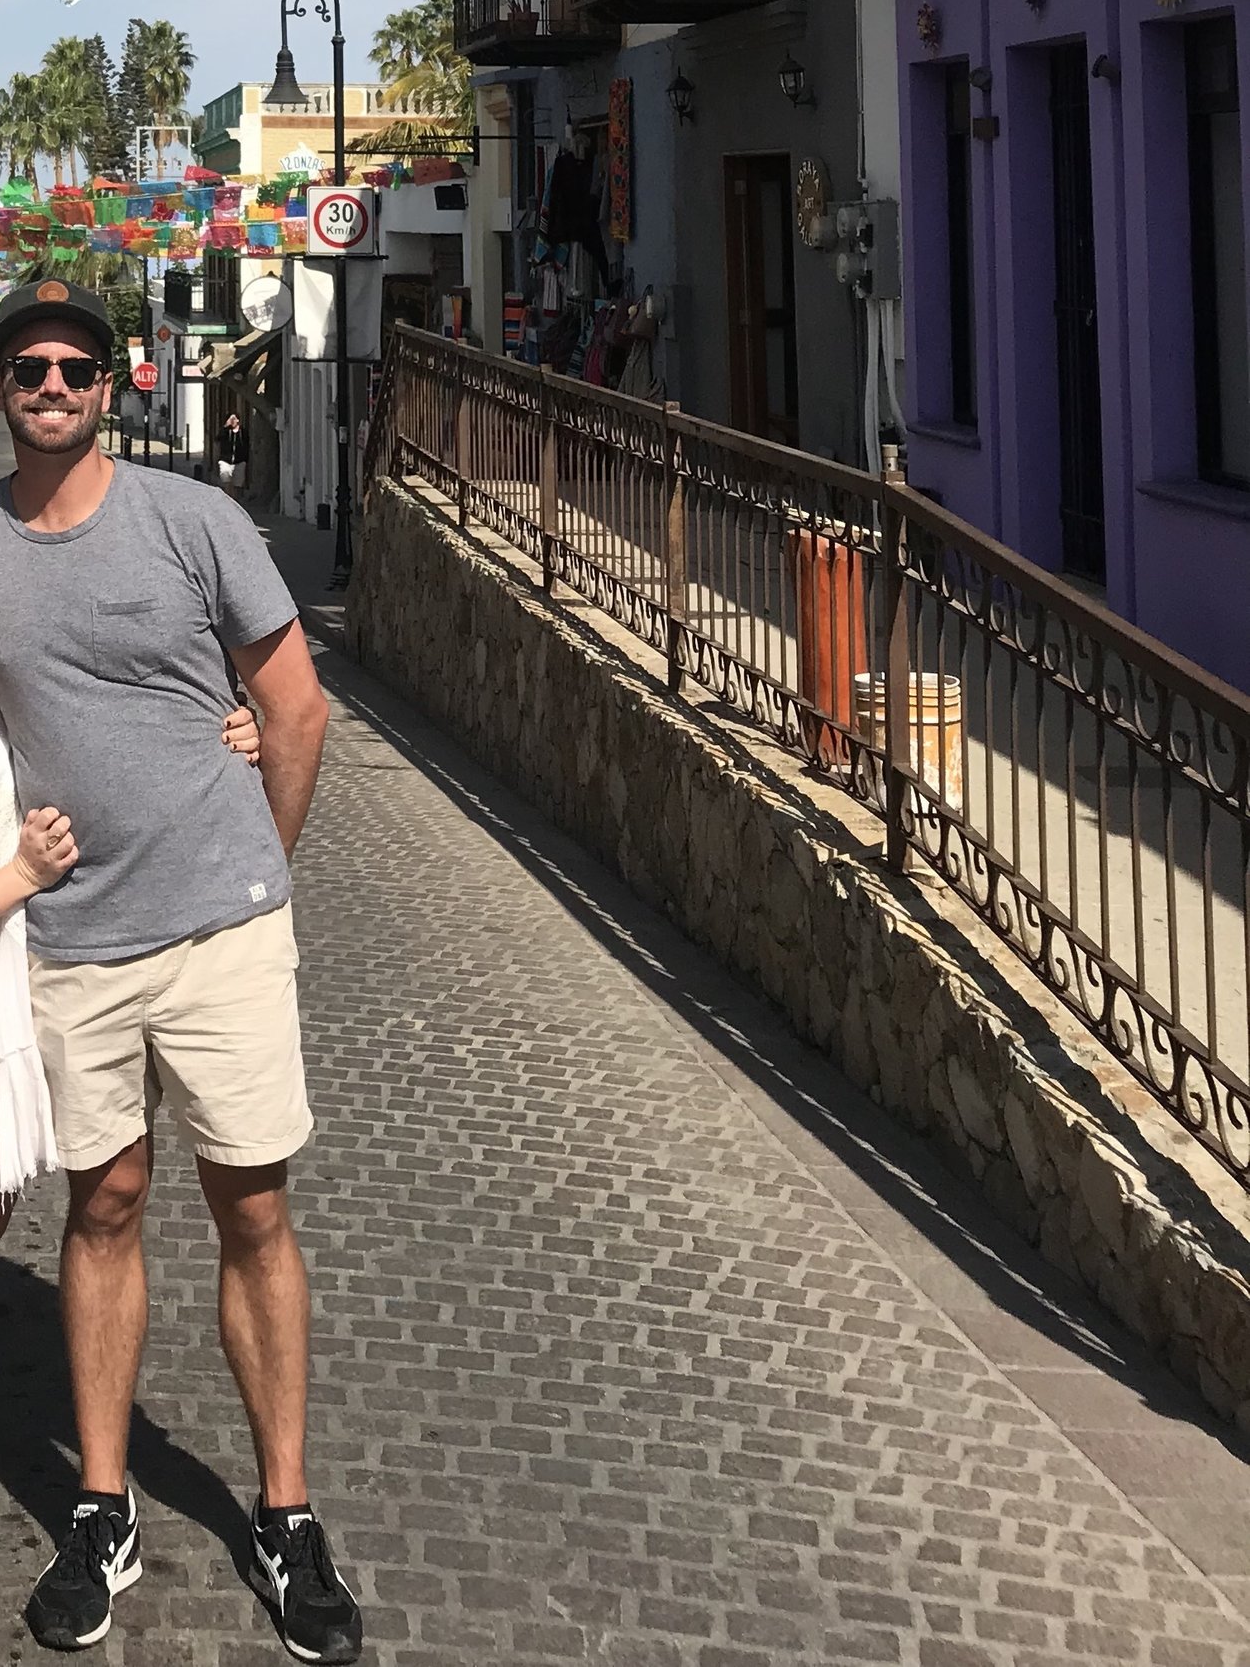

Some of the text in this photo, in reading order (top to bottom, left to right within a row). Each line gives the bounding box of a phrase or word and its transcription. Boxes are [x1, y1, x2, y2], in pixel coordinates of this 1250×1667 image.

[328, 202, 354, 223] 30
[326, 226, 356, 235] Km/h
[134, 370, 158, 383] ALTO
